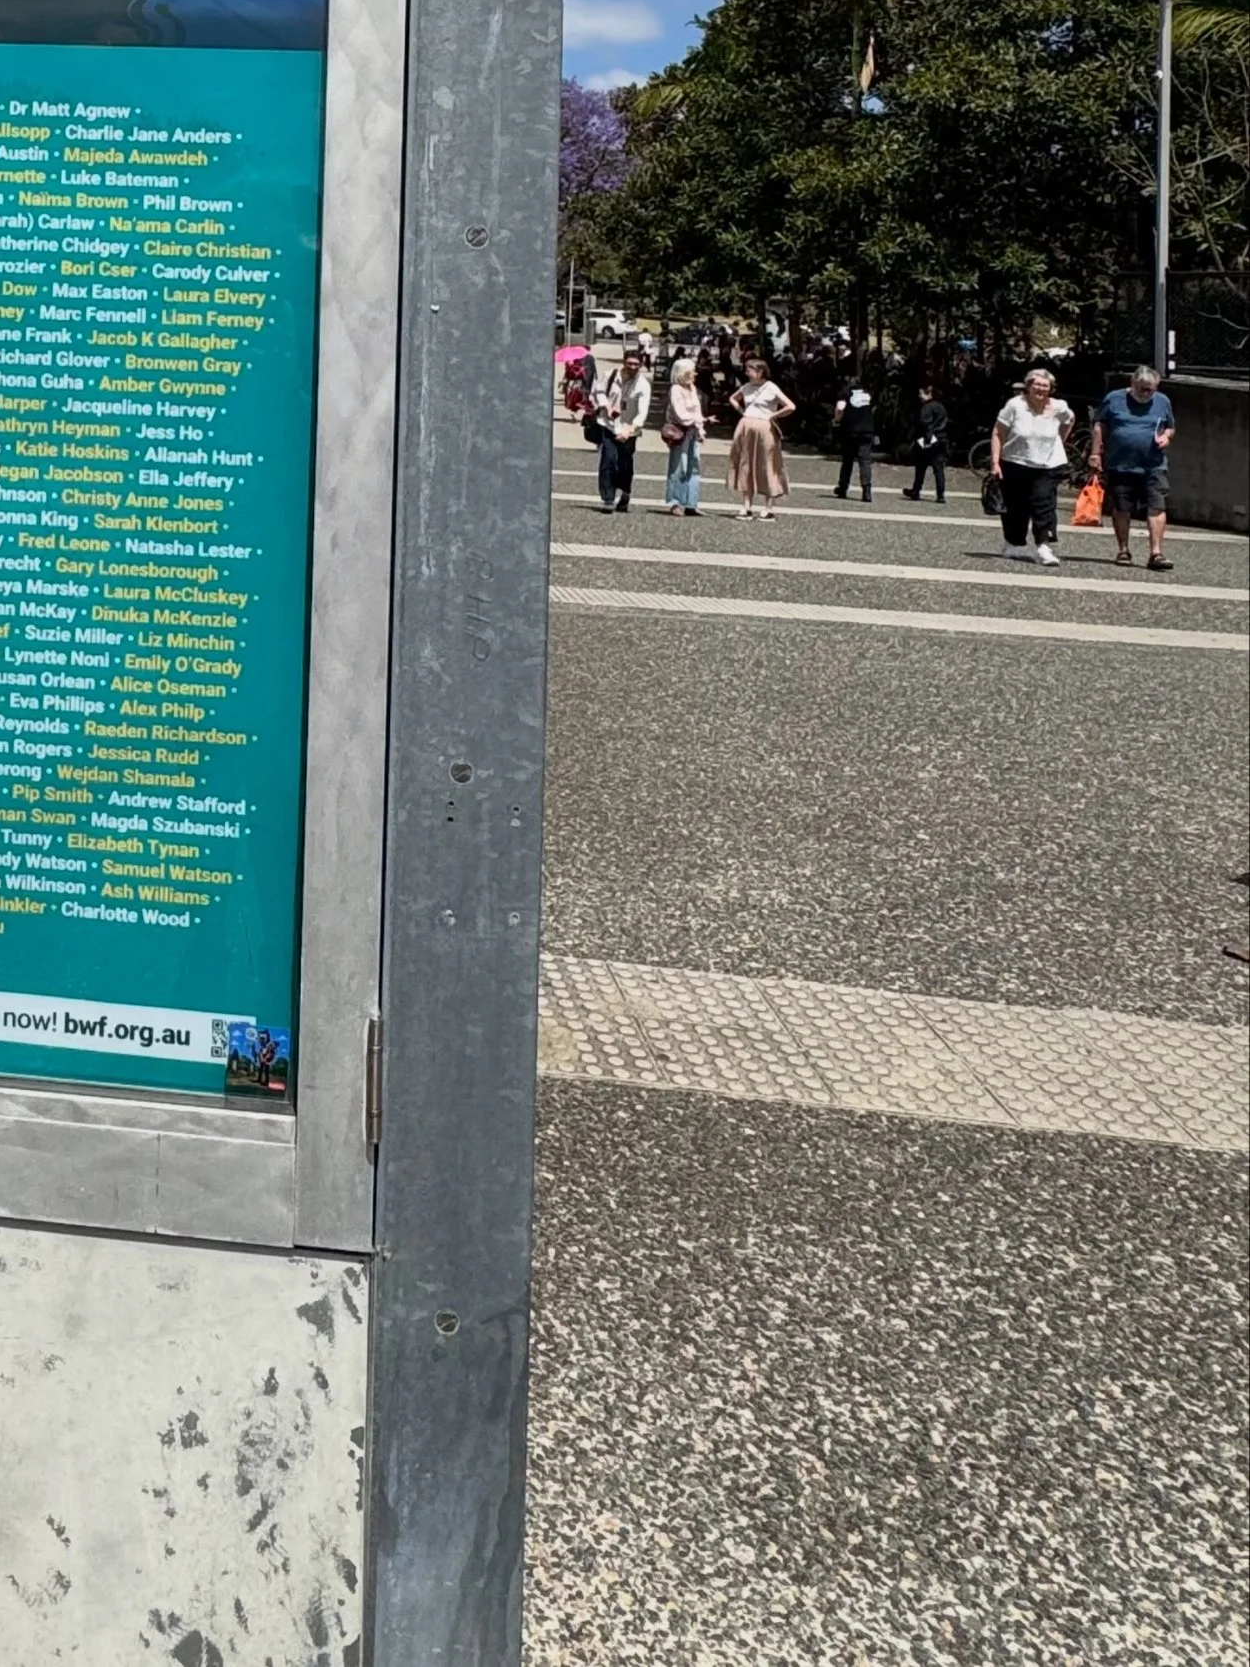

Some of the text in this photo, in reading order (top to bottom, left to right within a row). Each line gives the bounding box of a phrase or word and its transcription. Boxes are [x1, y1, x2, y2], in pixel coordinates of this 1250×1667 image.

[10, 100, 28, 115] Dr
[32, 101, 70, 117] Matt
[74, 102, 130, 122] Agnew
[76, 192, 128, 209] Brown
[143, 194, 175, 211] Phil
[180, 196, 232, 212] Brown
[3, 281, 37, 296] Dow
[53, 282, 87, 298] Max
[92, 284, 147, 301] Easton
[164, 287, 210, 303] Laura
[214, 288, 265, 309] Elvery
[41, 373, 84, 390] Guha
[99, 375, 155, 393] Amber
[159, 378, 226, 398] Gwynne
[41, 510, 78, 531] King
[94, 513, 141, 531] Sarah
[146, 516, 218, 534] Klenbort
[5, 647, 67, 666] Lynette
[71, 651, 109, 667] Noni
[125, 653, 171, 674] Emily
[14, 738, 72, 759] Rogers
[88, 744, 151, 762] Jessica
[156, 748, 199, 765] Rudd
[25, 853, 86, 872] Watson
[102, 859, 165, 879] Samuel
[169, 864, 232, 884] Watson
[3, 1012, 57, 1032] now!
[64, 1012, 191, 1047] bwf.org.au
